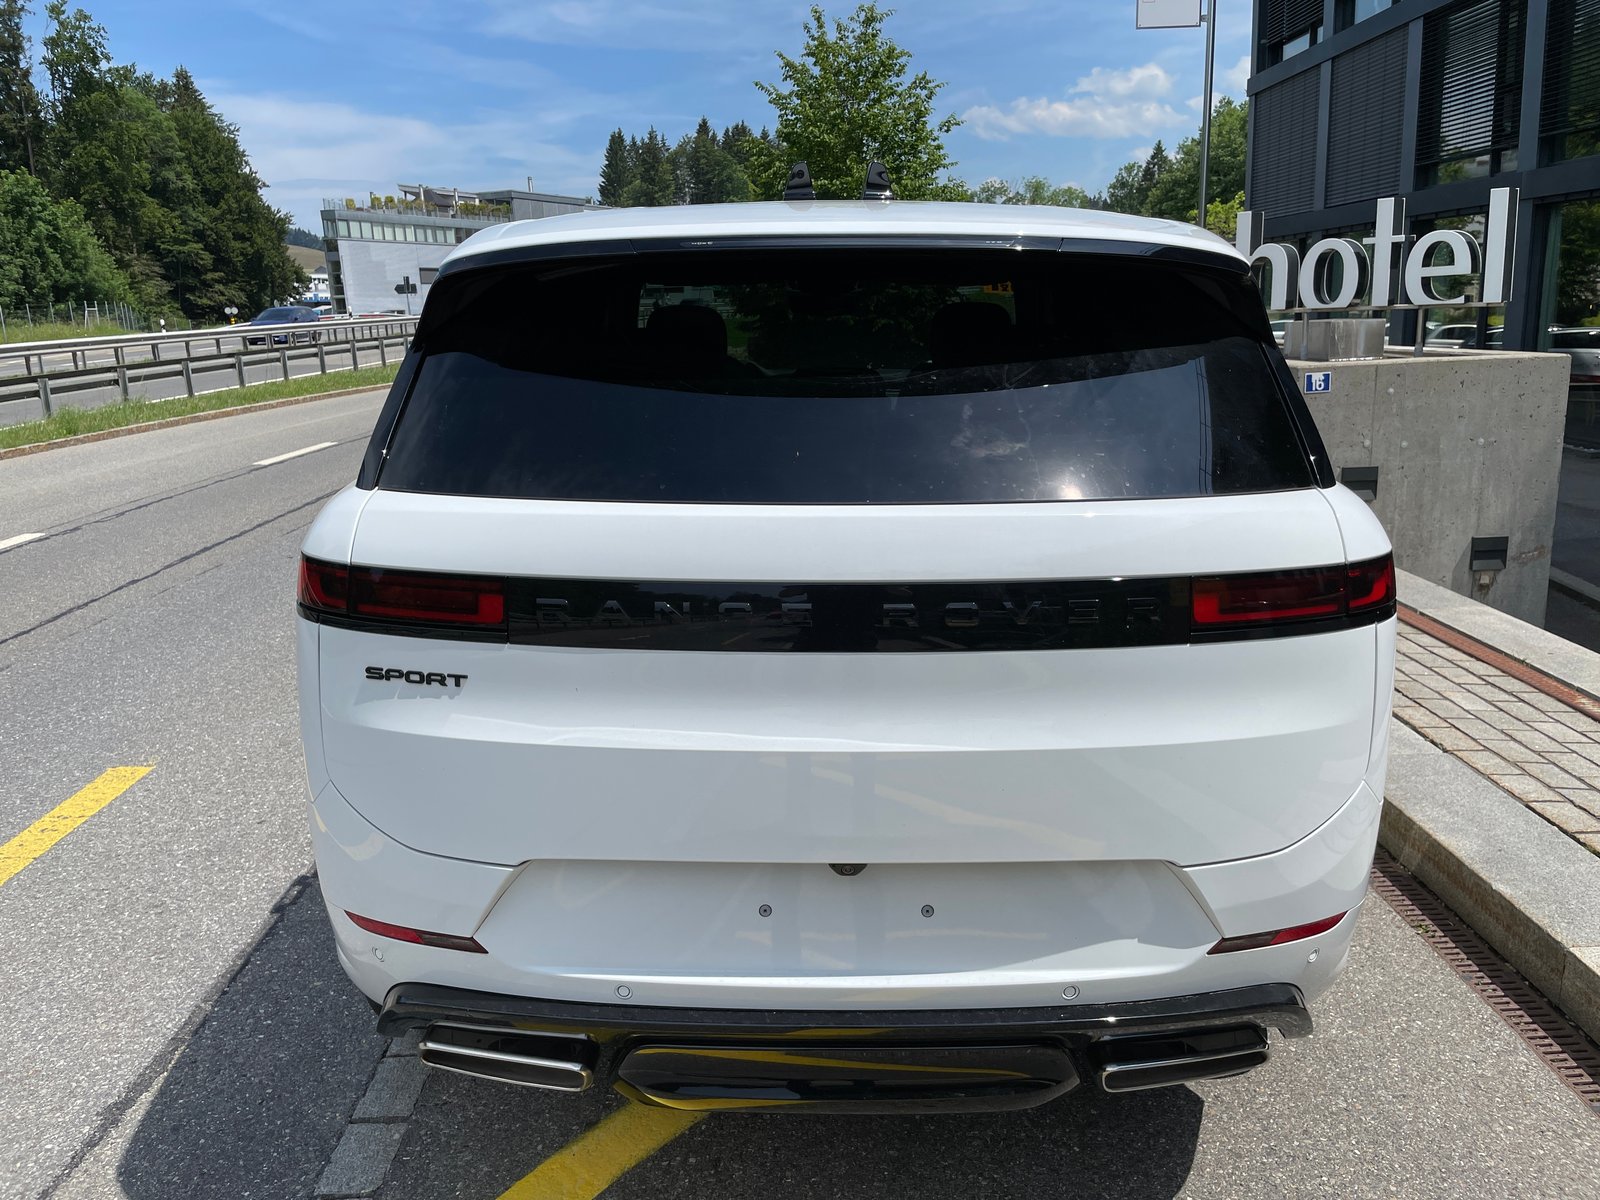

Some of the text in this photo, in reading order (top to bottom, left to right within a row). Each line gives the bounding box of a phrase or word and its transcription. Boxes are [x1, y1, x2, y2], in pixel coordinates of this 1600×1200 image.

[1236, 187, 1512, 310] hotel
[535, 597, 1161, 628] RANGE ROVER
[365, 666, 468, 688] SPORT
